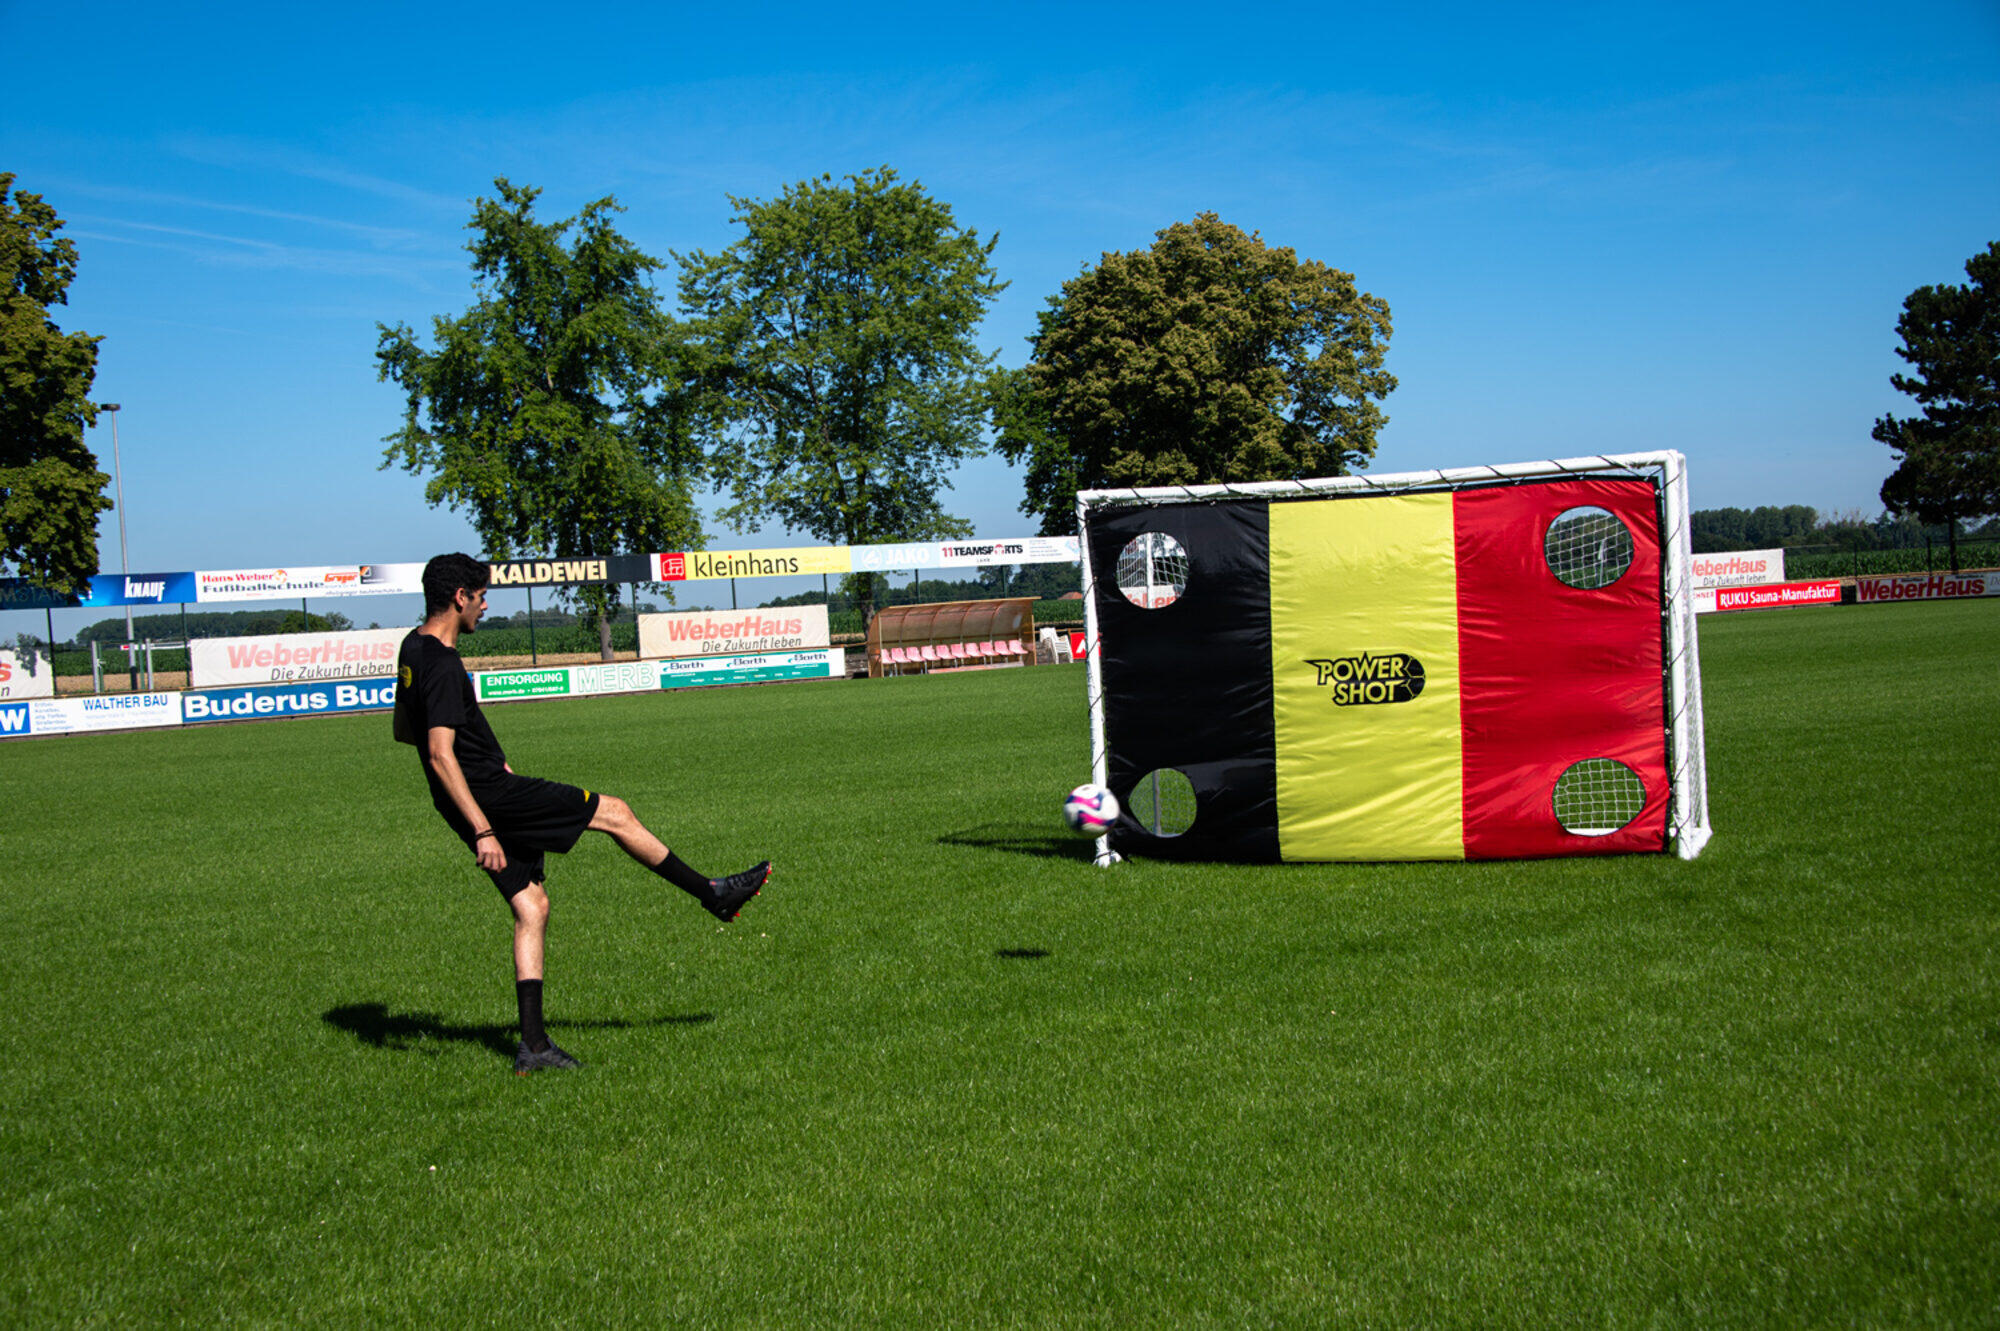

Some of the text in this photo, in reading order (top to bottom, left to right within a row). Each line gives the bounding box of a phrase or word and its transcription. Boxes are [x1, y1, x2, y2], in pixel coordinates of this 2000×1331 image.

[694, 553, 799, 578] kleinhans
[885, 547, 930, 565] JAKO
[202, 572, 274, 583] Hans Weber
[490, 560, 607, 586] KALDEWEI
[1703, 577, 1717, 586] Die
[203, 581, 325, 593] Fußballschule
[1720, 586, 1836, 607] RUKU Sauna-Manufaktur
[1858, 576, 1985, 601] WeberHaus
[668, 616, 802, 641] WeberHaus
[227, 640, 395, 669] WeberHaus
[702, 636, 802, 653] Die Zukunft leben
[271, 662, 393, 681] Die Zukunft leben
[670, 661, 704, 670] Barth
[1311, 656, 1405, 684] POWER
[486, 671, 564, 687] ENTSORGUNG
[576, 664, 655, 693] MERB
[185, 682, 397, 719] Buderus Bud
[1334, 680, 1405, 704] SHOT
[83, 694, 168, 712] WALTHER BAU
